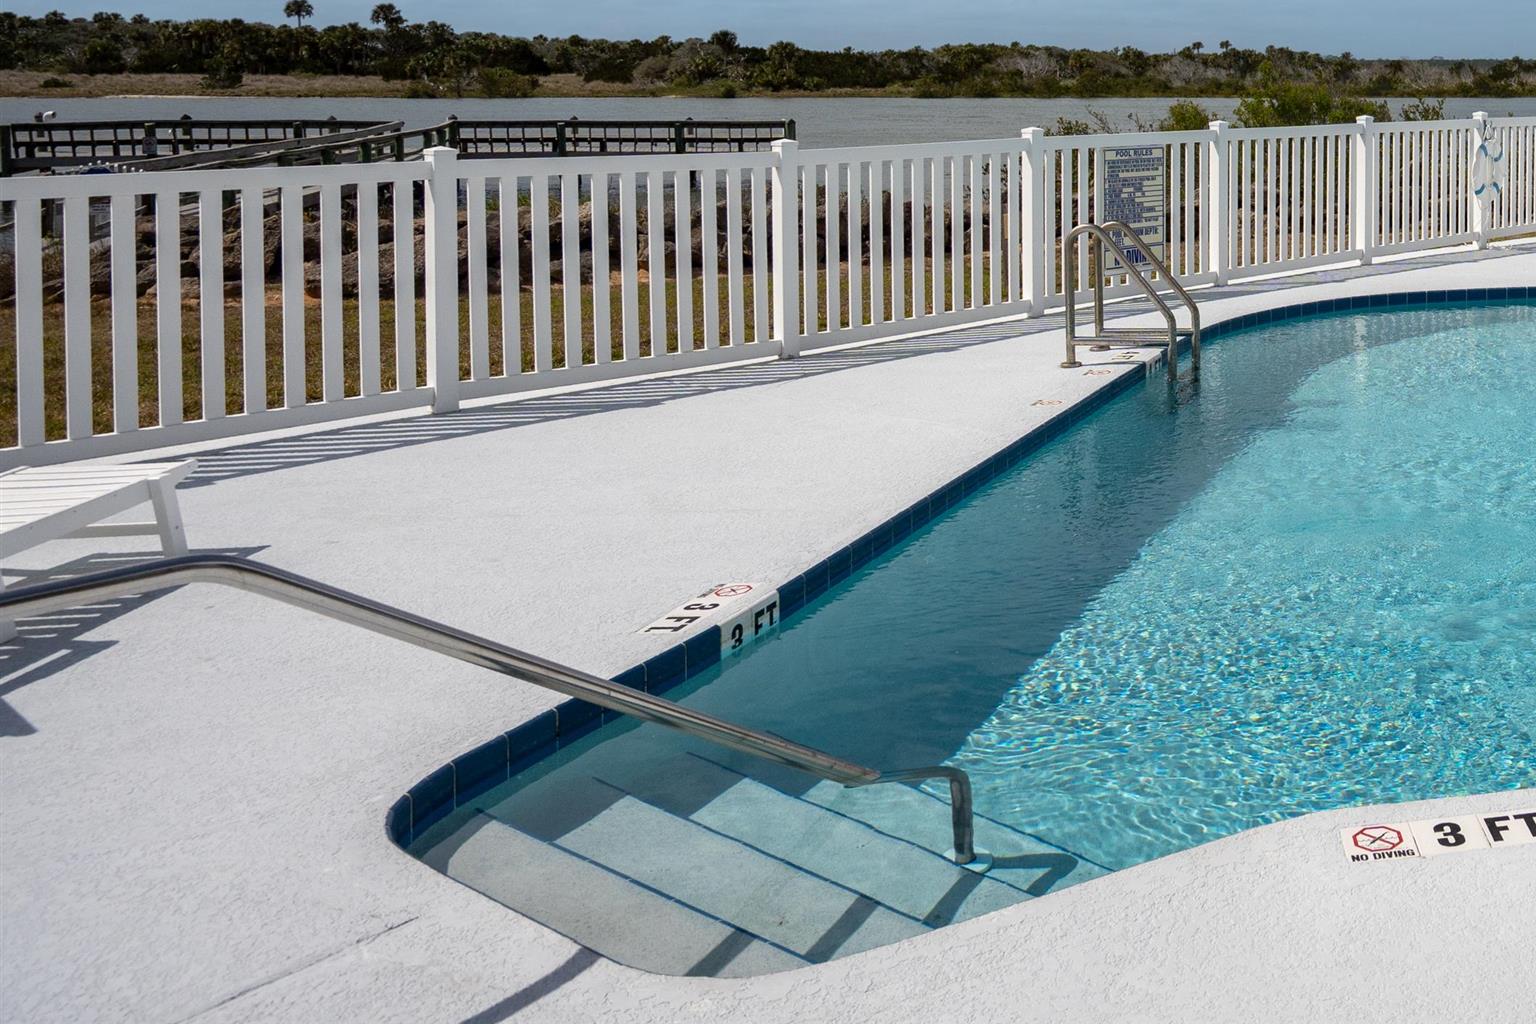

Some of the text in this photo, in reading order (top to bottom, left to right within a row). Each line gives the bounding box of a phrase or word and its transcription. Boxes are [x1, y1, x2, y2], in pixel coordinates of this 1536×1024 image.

[683, 602, 720, 611] 3
[731, 623, 744, 649] 3
[1433, 822, 1466, 847] 3
[1351, 849, 1415, 863] NO DIVING
